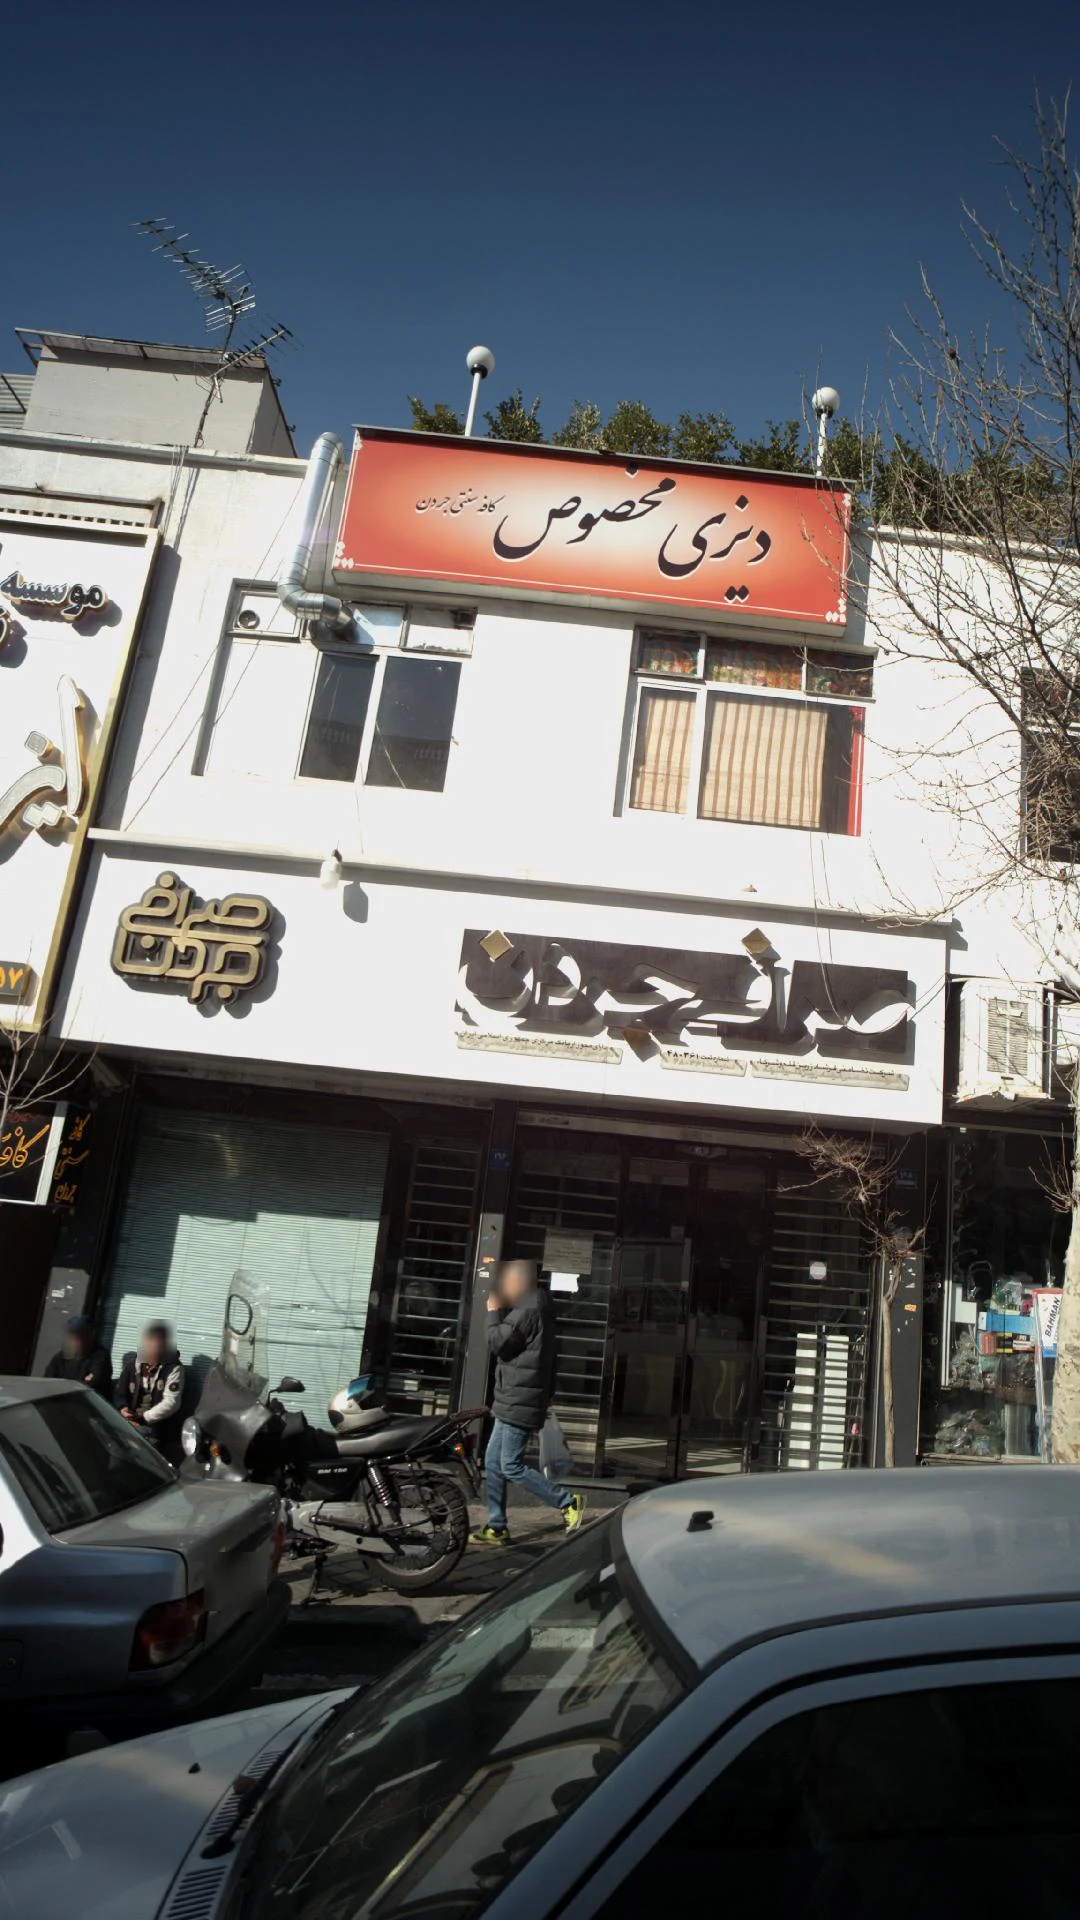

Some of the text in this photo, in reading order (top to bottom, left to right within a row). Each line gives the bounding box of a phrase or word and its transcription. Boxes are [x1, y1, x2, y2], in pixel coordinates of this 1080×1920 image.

[415, 488, 506, 514] کافه سنتی جردن
[493, 461, 772, 603] دیزی مخصوص
[1044, 1297, 1061, 1338] BAHMAN
